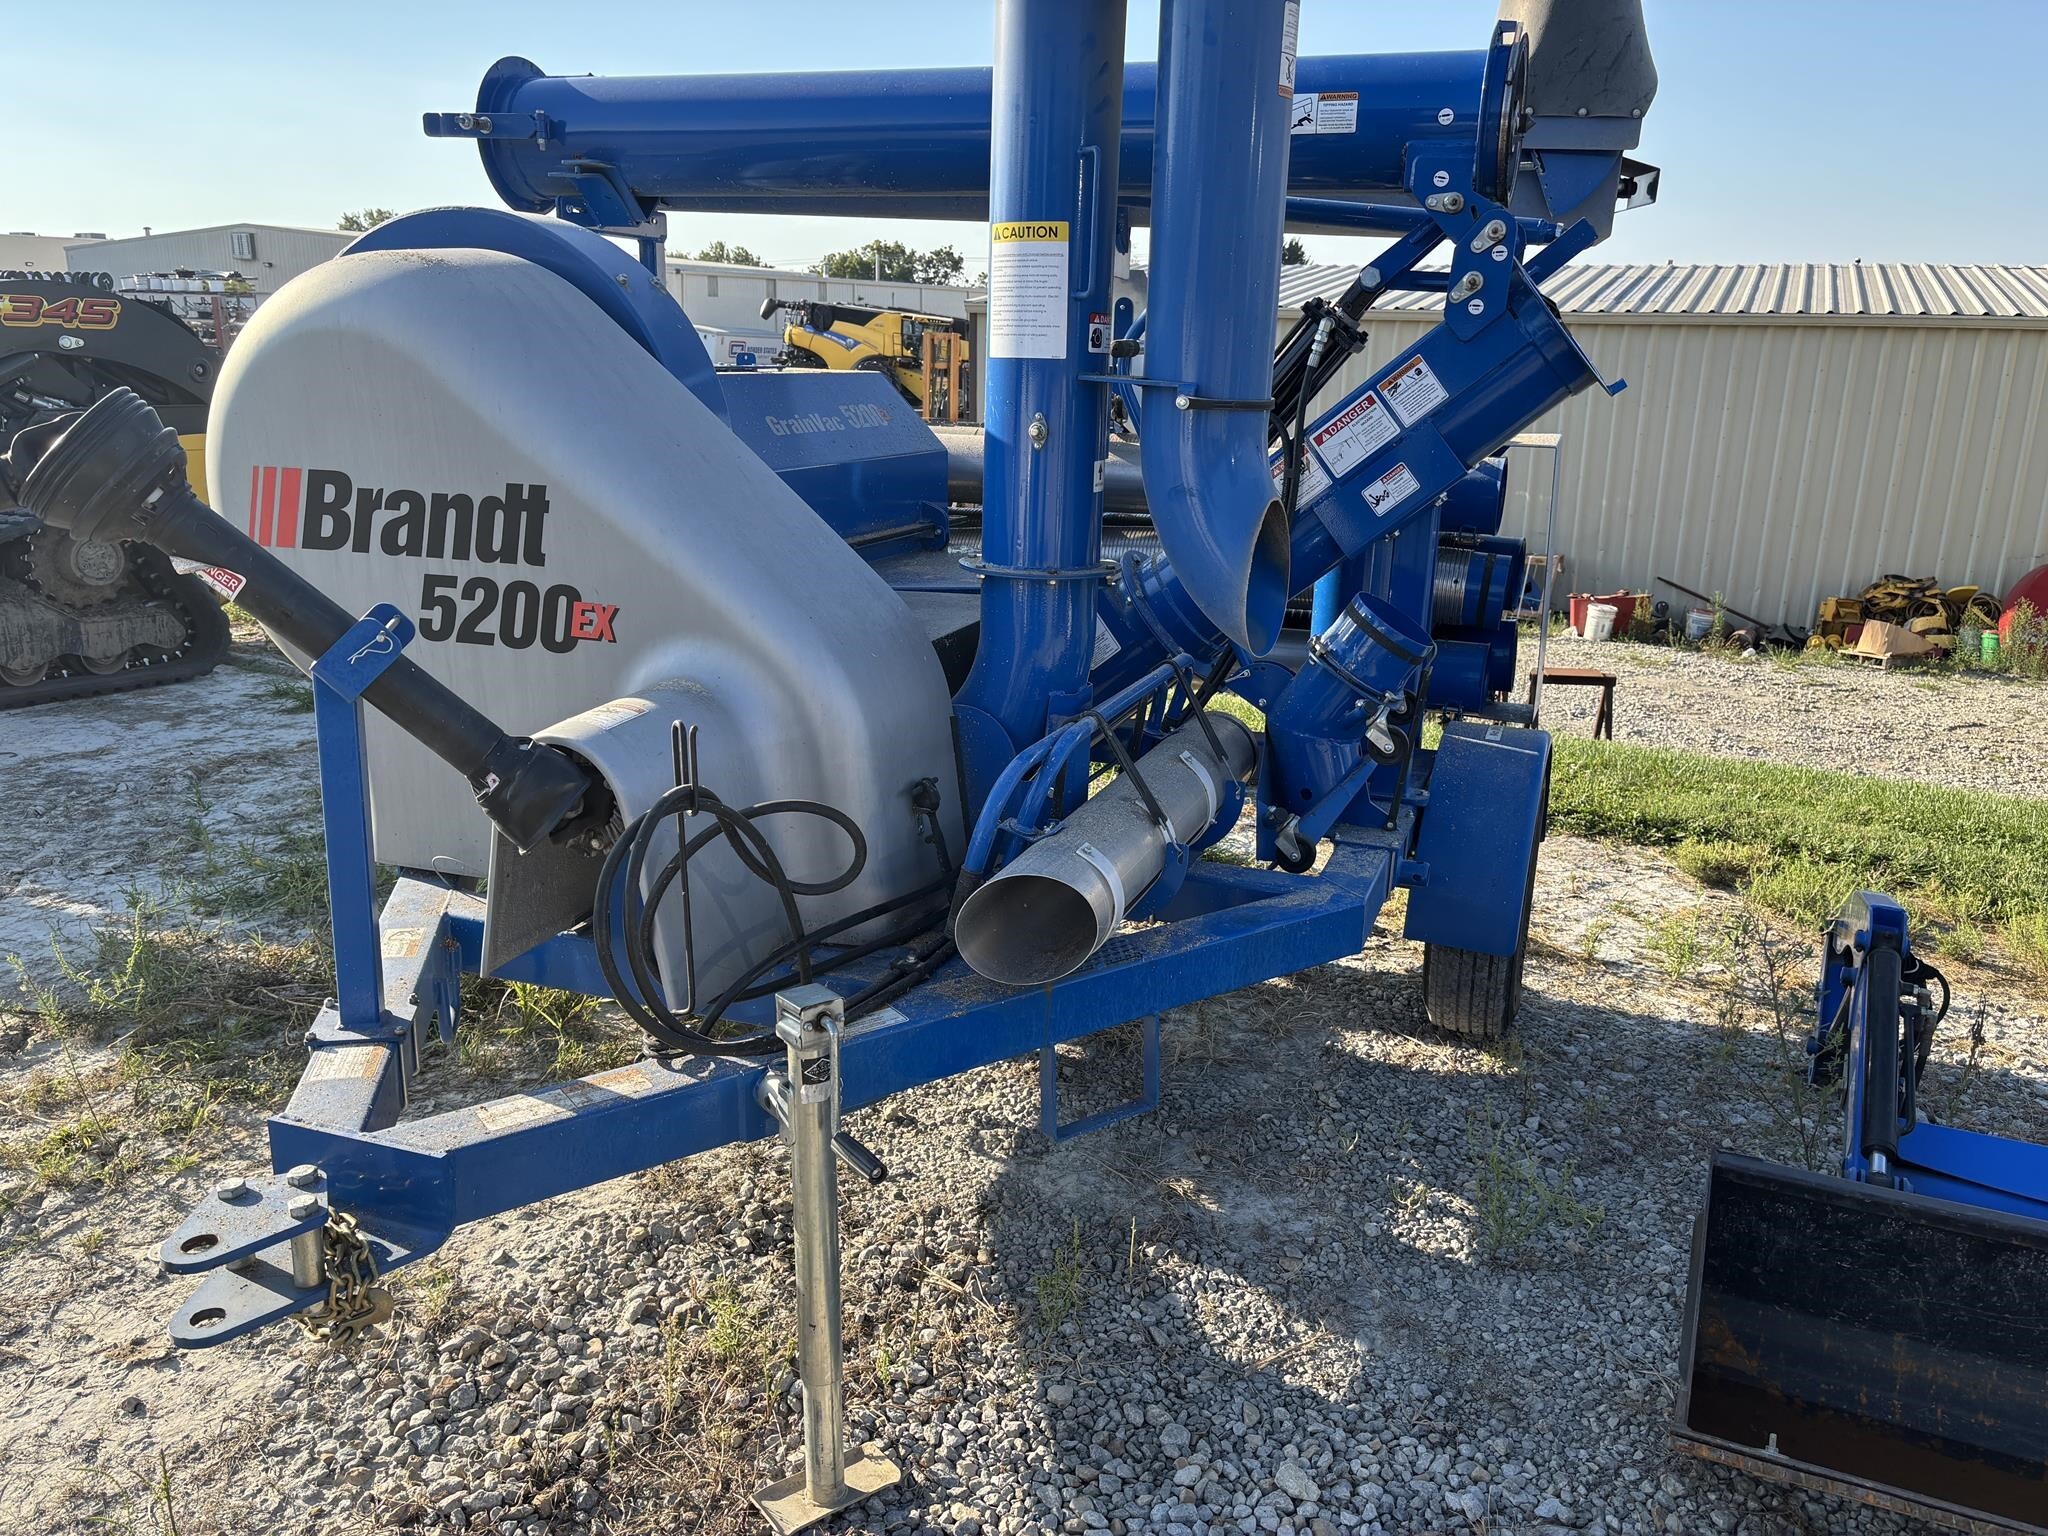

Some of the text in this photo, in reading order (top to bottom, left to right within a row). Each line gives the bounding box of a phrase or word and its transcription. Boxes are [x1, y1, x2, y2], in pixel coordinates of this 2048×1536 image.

[1002, 225, 1058, 239] CAUTION
[1392, 362, 1416, 383] WARNING
[765, 413, 846, 435] GrainVac
[1329, 399, 1371, 435] DANGER
[1385, 465, 1404, 482] DANGER
[302, 469, 550, 567] Brandt
[205, 566, 240, 592] NGER
